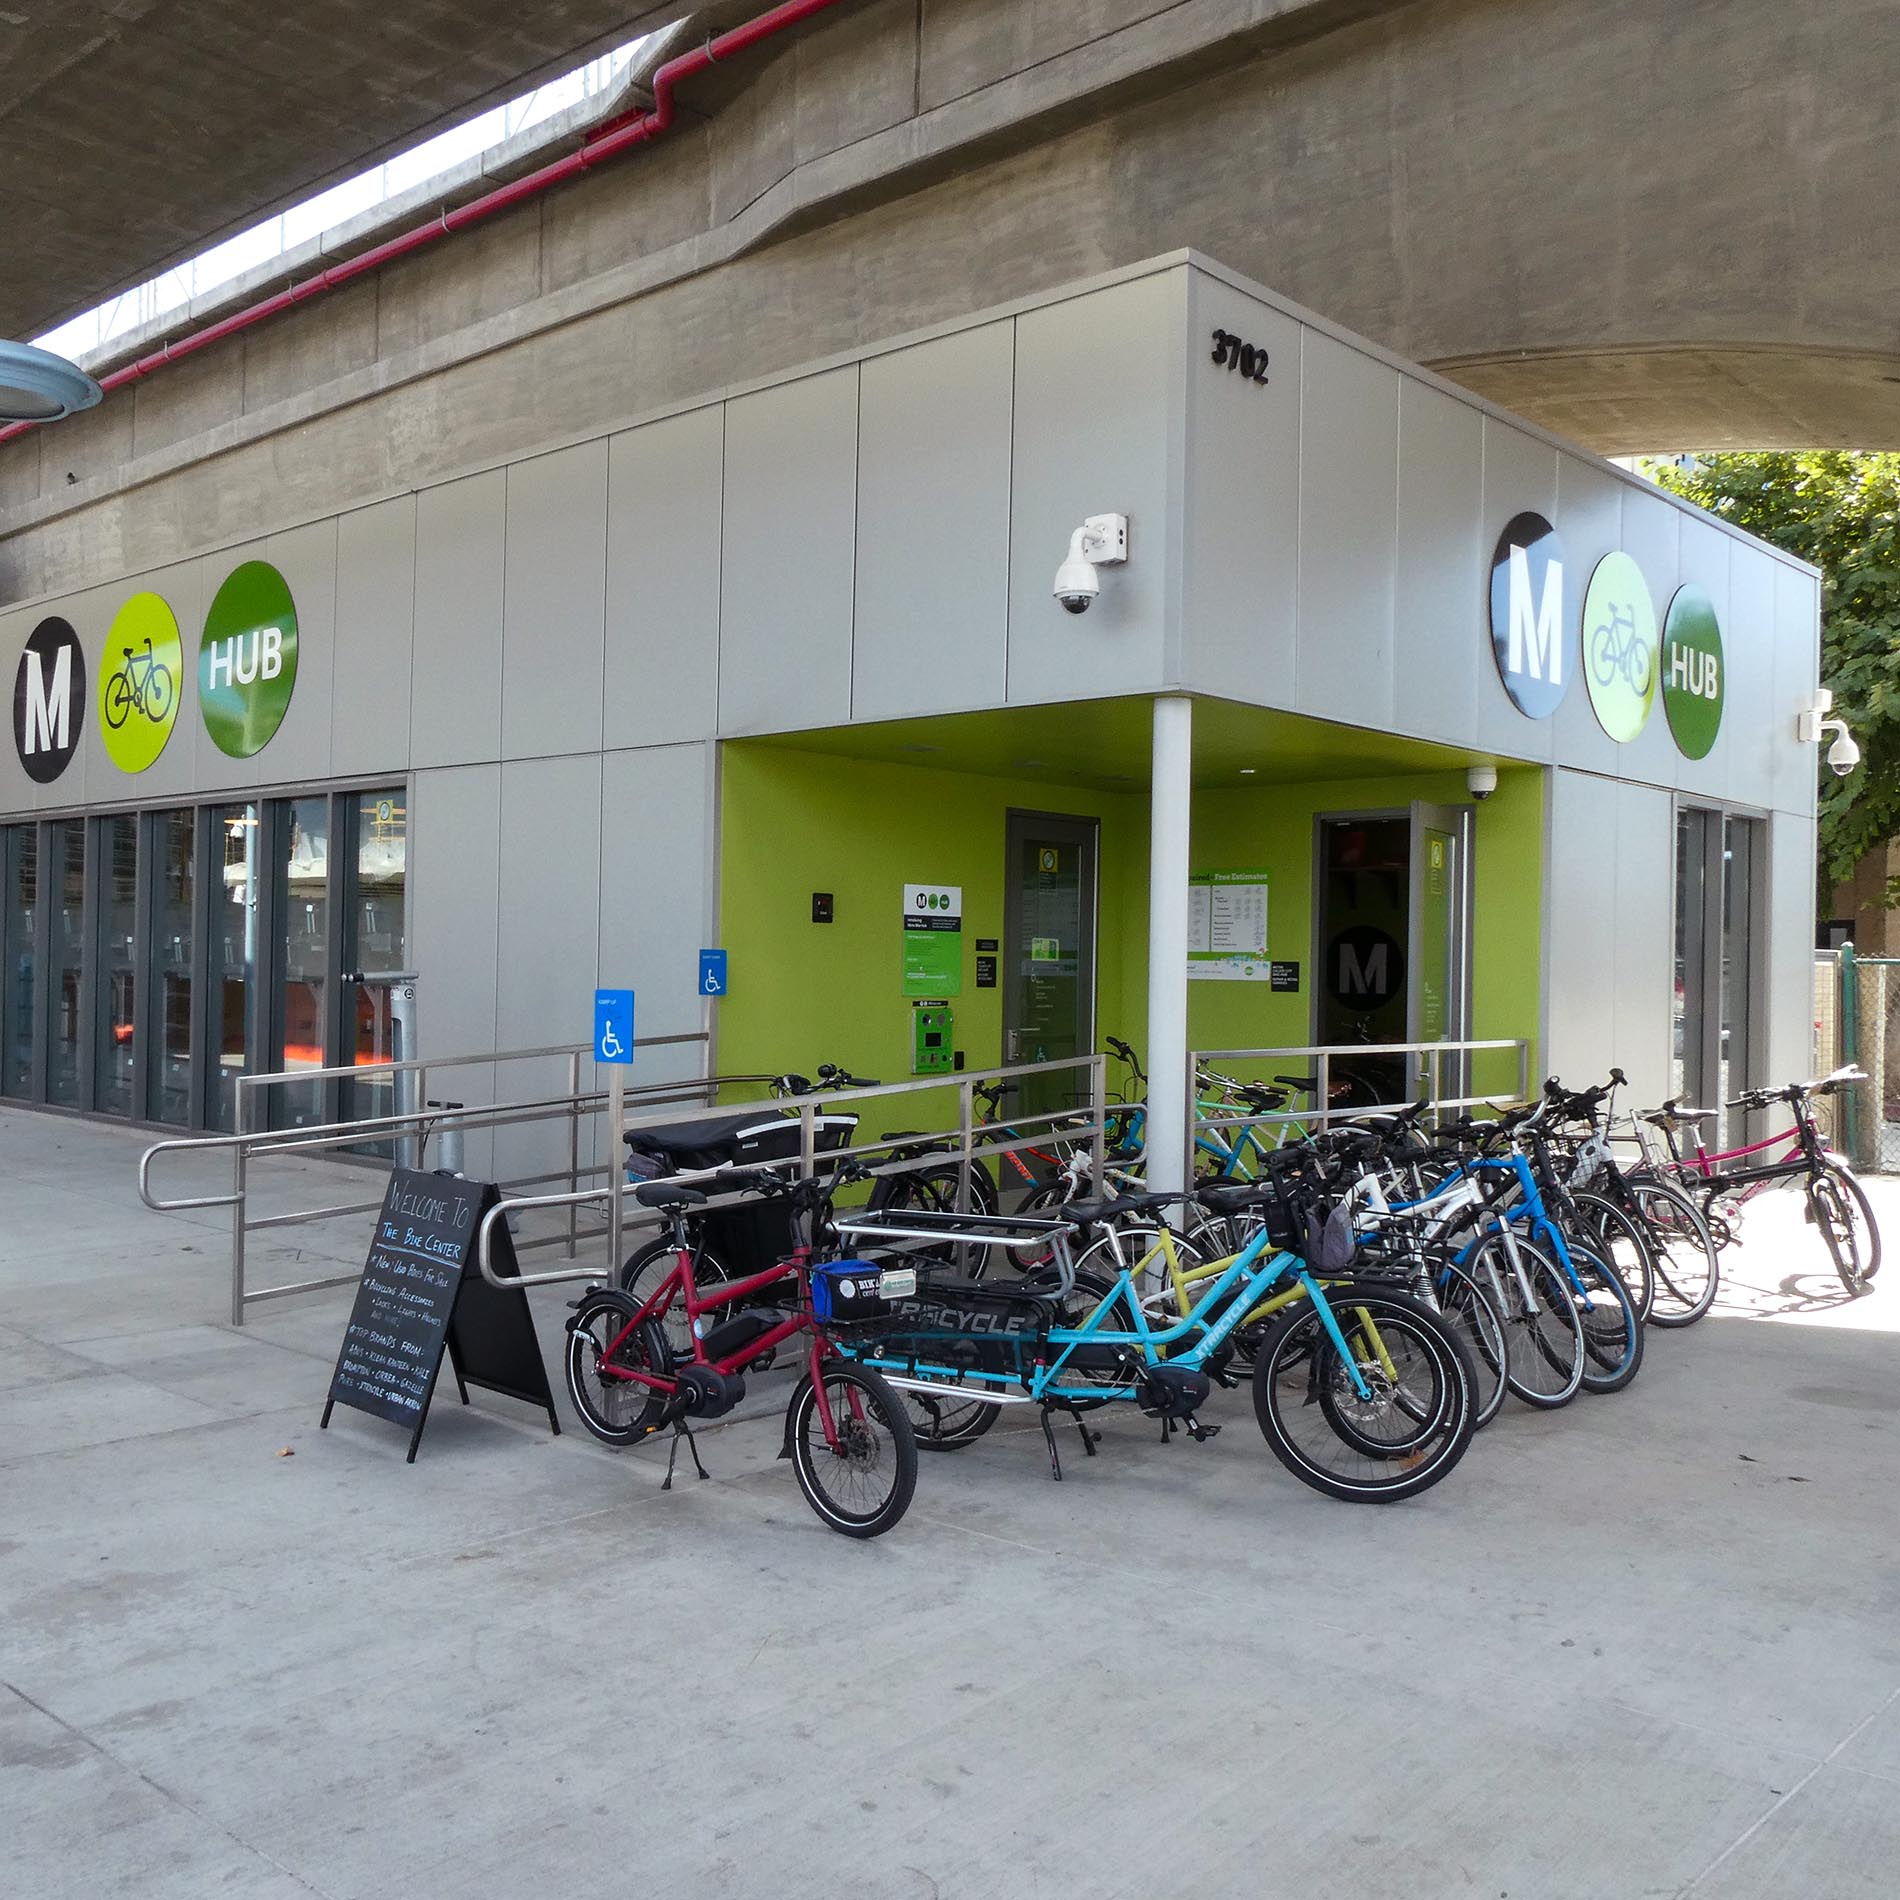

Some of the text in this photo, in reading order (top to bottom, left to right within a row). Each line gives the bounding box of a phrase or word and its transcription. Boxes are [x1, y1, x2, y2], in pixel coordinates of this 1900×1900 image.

[1211, 328, 1269, 385] 3702
[1508, 543, 1718, 700] M HUB
[24, 626, 283, 756] M HUB
[1339, 943, 1388, 994] M
[390, 1181, 470, 1229] WELCOME TO
[382, 1222, 461, 1259] THE BIKE CENTER
[370, 1330, 397, 1349] BRANDS
